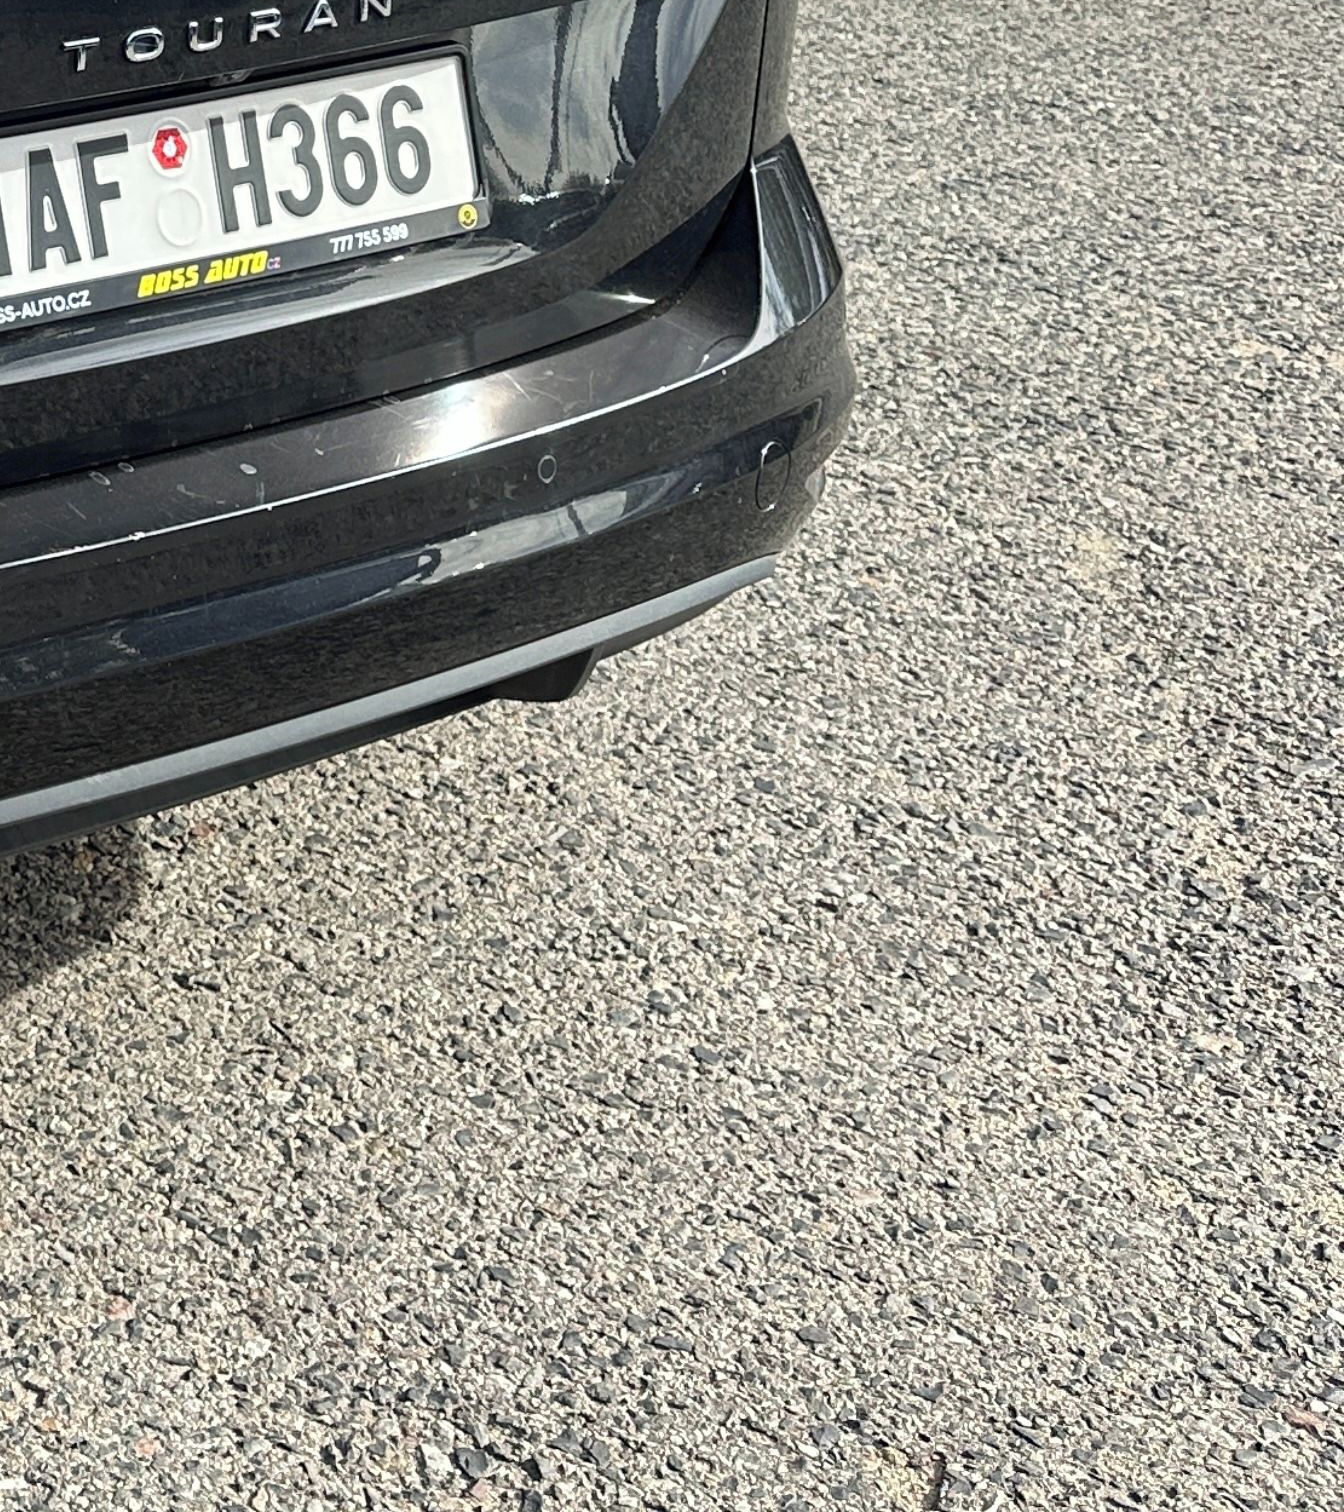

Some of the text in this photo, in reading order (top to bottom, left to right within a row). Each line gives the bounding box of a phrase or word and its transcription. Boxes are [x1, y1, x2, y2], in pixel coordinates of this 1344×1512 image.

[209, 85, 432, 234] H366
[137, 270, 200, 298] BOSS
[204, 251, 269, 285] AUTO
[354, 228, 381, 249] 755
[382, 222, 409, 244] 599
